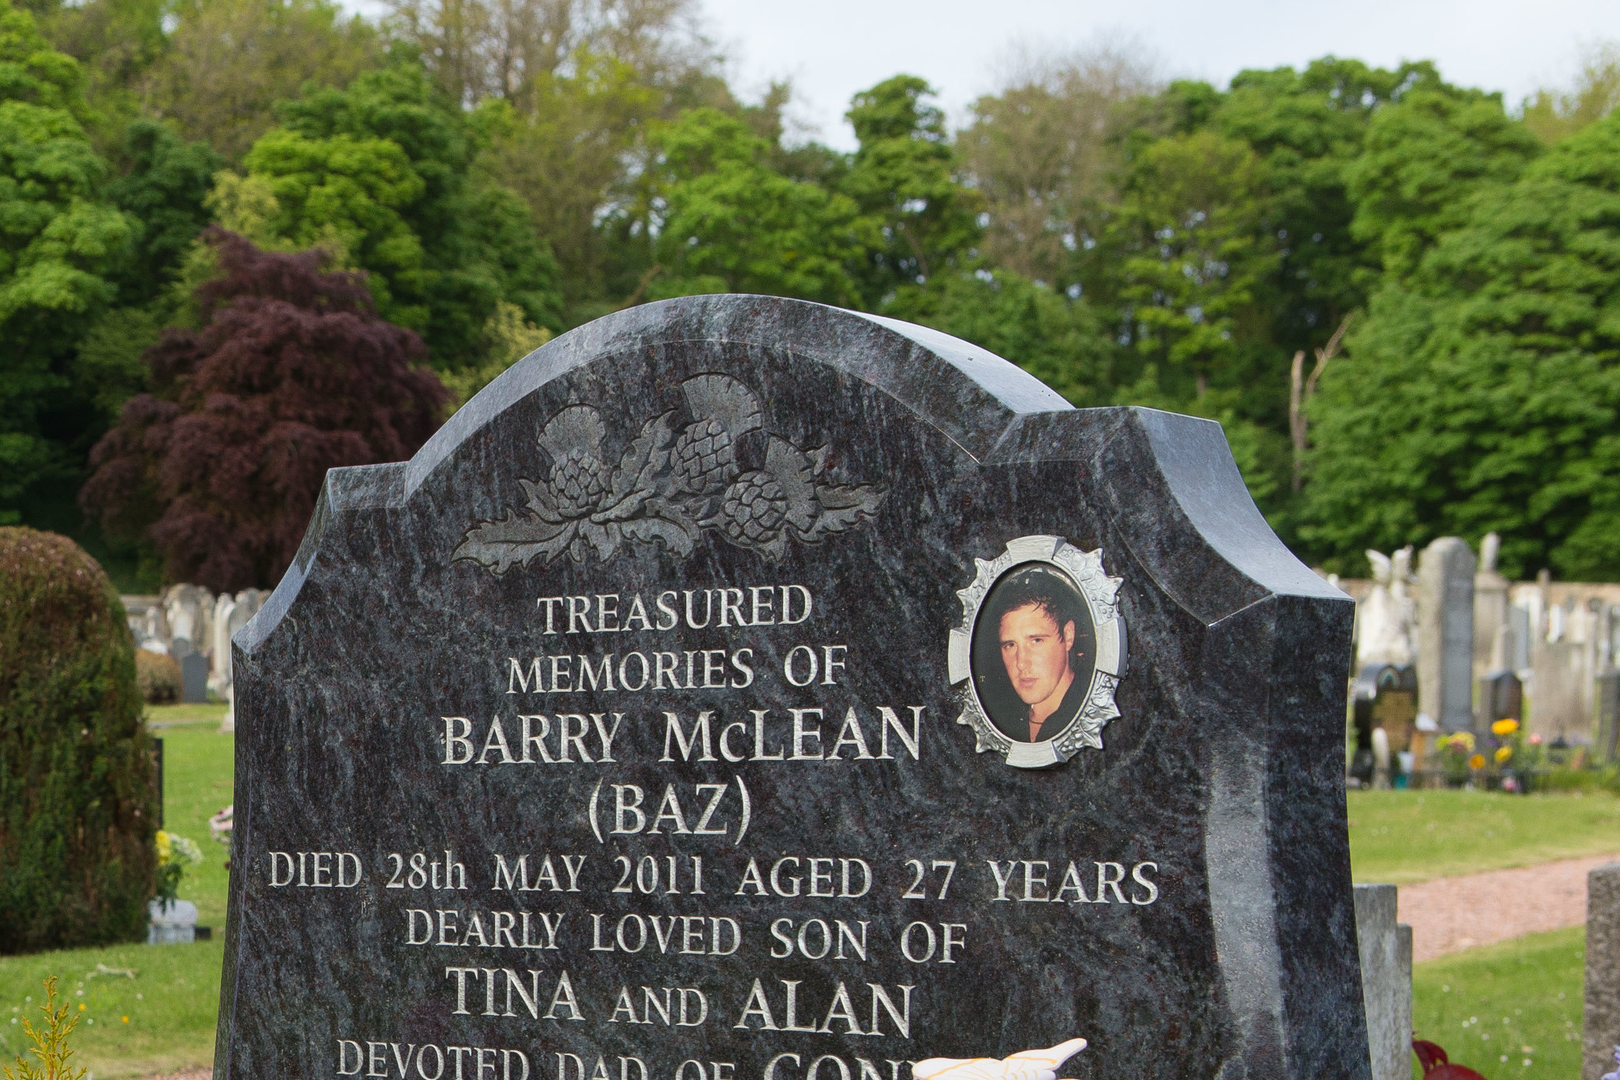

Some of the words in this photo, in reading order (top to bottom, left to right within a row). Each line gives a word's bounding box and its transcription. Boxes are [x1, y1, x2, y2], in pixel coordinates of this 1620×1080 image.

[537, 583, 813, 636] TREASURED
[507, 649, 756, 695] MEMORIES
[784, 644, 848, 687] OF
[441, 711, 625, 766] BARRY
[657, 705, 925, 764] McLEAN
[590, 776, 752, 845] (BAZ)
[269, 850, 363, 889] DIED
[386, 851, 467, 891] 28th
[492, 854, 586, 893] MAY
[613, 855, 704, 894] 2011
[735, 858, 873, 898] AGED
[902, 858, 952, 901] 27
[986, 859, 1159, 905] YEARS
[406, 908, 565, 949] DEARLY
[592, 914, 741, 955] LOVED
[770, 919, 869, 961] SON
[901, 922, 967, 964] OF
[445, 967, 585, 1022] TINA
[612, 986, 709, 1028] AND
[735, 977, 916, 1039] ALAN
